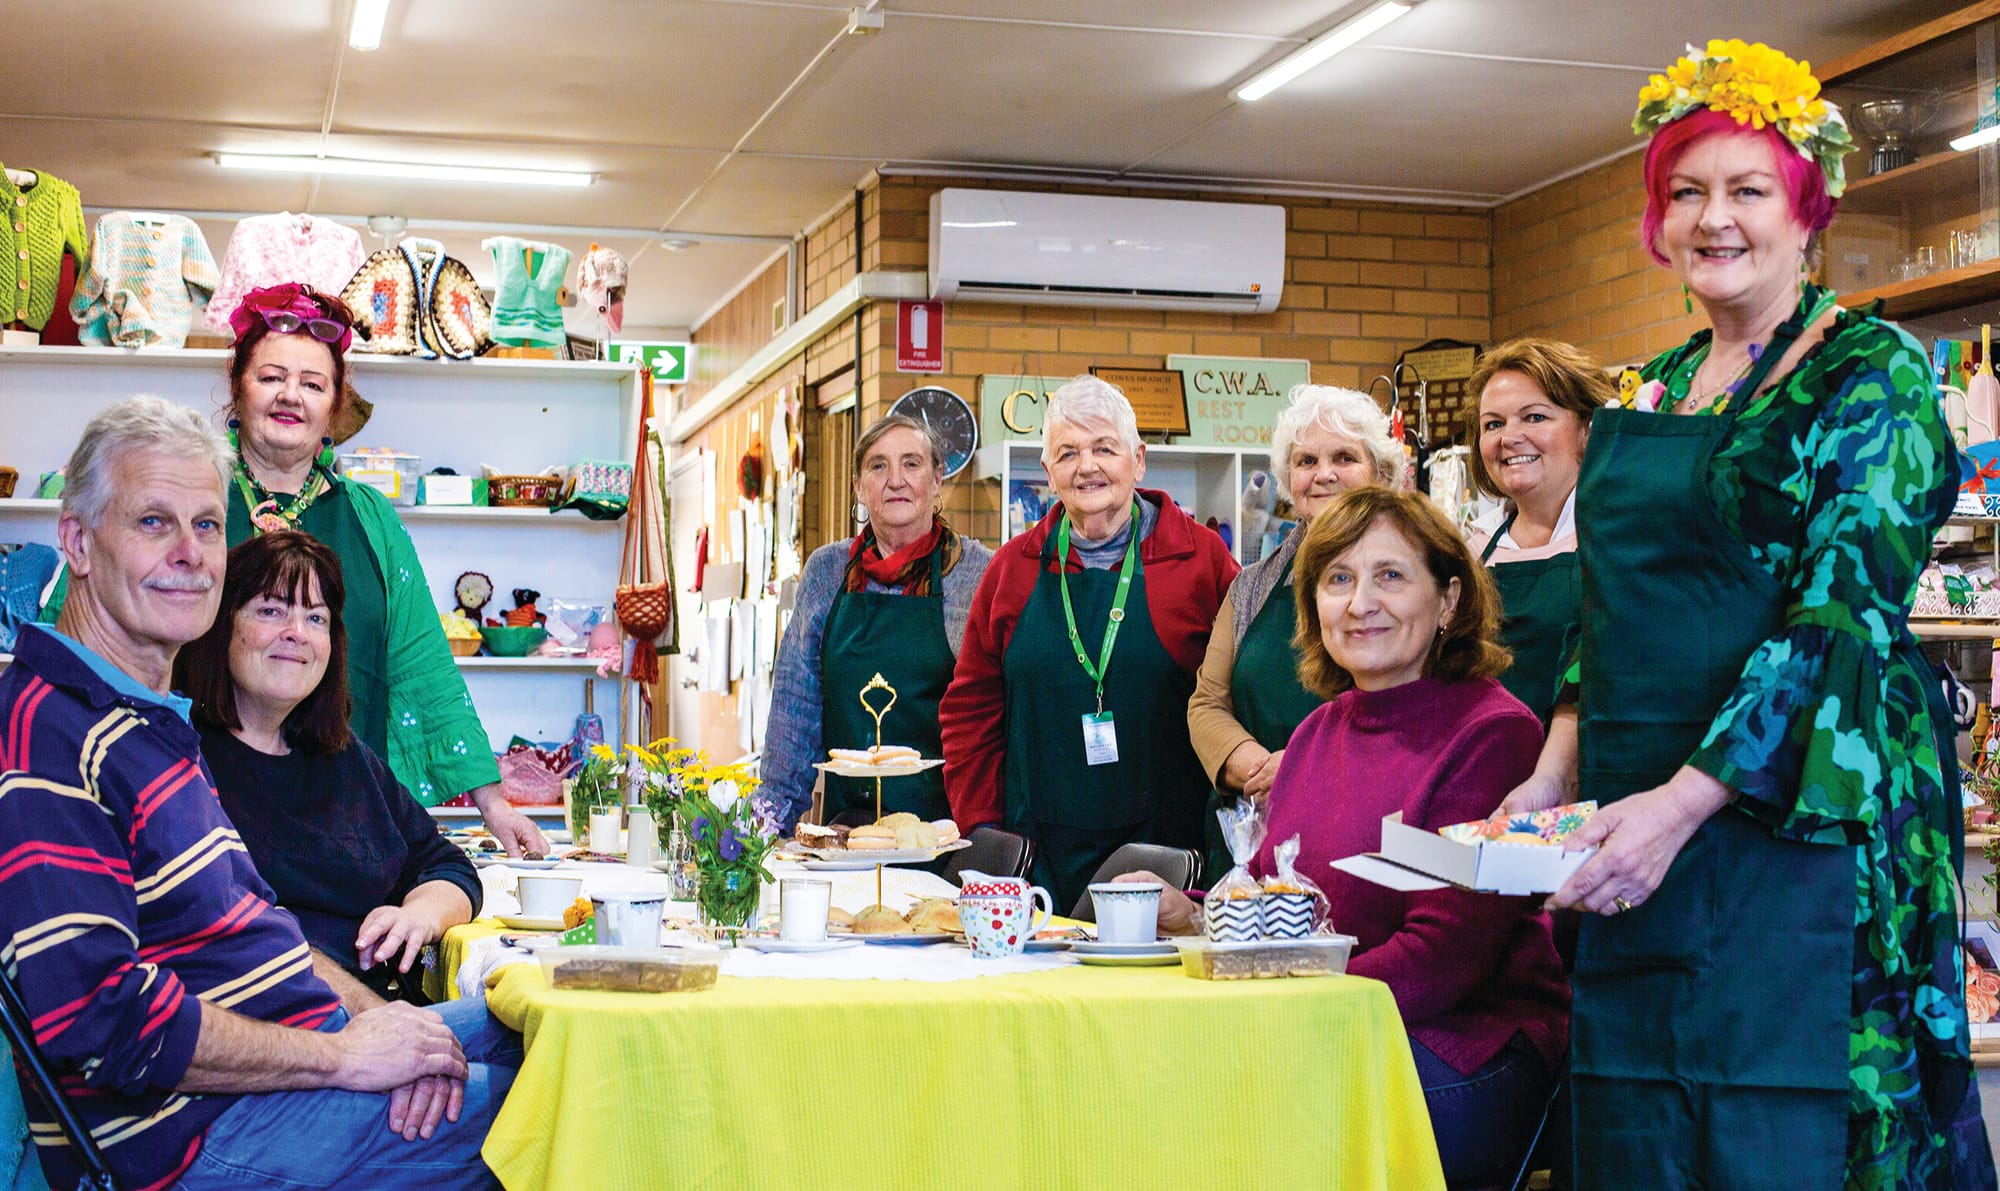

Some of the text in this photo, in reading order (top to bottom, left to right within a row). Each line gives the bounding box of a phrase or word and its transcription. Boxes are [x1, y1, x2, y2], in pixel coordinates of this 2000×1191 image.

[1136, 376, 1171, 384] BRANCH
[1194, 369, 1281, 396] C.W.A.
[1197, 400, 1246, 420] REST
